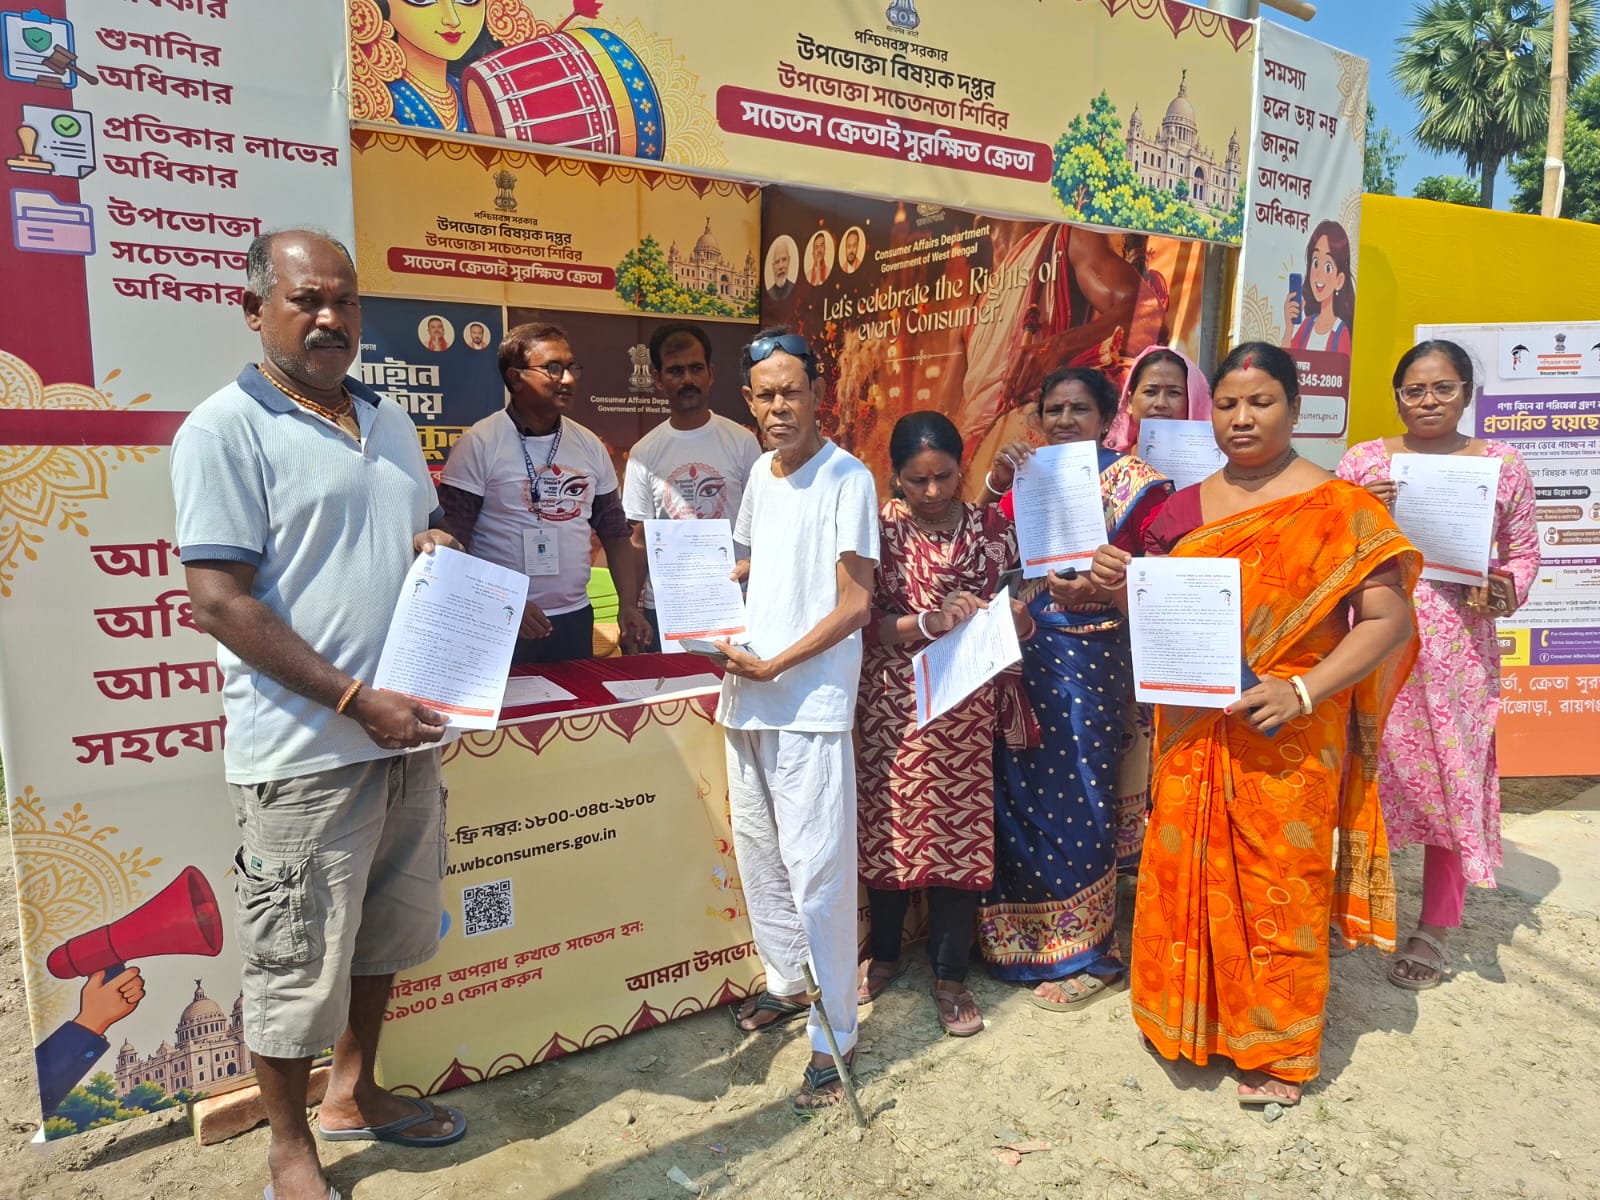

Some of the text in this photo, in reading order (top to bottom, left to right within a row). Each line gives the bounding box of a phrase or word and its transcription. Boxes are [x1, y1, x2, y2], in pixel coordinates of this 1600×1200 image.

[96, 27, 222, 67] শুনানির
[854, 29, 909, 54] পশ্চিমবঙ্গ
[910, 43, 949, 63] সরকার
[97, 64, 233, 105] অধিকার
[797, 33, 996, 101] উপভোক্তা বিষয়ক দপ্তর
[1264, 58, 1306, 92] সমস্যা
[778, 61, 1010, 132] উপভোক্তা সচেতনতা শিবির
[1263, 95, 1338, 139] হলে ভয় নয়
[103, 114, 338, 167] প্রতিকার লাভের
[740, 100, 1035, 172] সচেতন ক্রেতাই সুরক্ষিত ক্রেতা
[1261, 131, 1299, 163] জানুন
[103, 152, 238, 189] অধিকার
[1258, 167, 1312, 200] আপনার
[108, 196, 262, 239] উপভোক্তা
[437, 216, 572, 246] উপভোক্তা বিষয়ক দপ্তর
[511, 216, 538, 227] সরকার
[1255, 198, 1310, 234] অধিকার
[110, 241, 248, 271] সচেতনত
[425, 232, 583, 262] উপভোক্তা সচেতনতা শিবির
[875, 224, 990, 261] Consumer Affairs Department
[881, 241, 978, 273] Government of West Bengal
[402, 253, 603, 285] সচেতন ক্রেতাই সুরক্ষিত ক্রেতা
[823, 250, 1063, 322] Let's celebrate the Rights of
[113, 273, 245, 306] অধিকার
[857, 302, 1003, 344] every Consumer.
[590, 395, 670, 406] Consumer Affairs Depa
[597, 405, 637, 413] Government
[1483, 411, 1600, 433] প্রতারিত হয়েছে
[93, 657, 225, 700] আমা
[1529, 676, 1570, 691] ক্রেতা
[1576, 676, 1600, 694] সুর
[72, 715, 227, 766] সহযো
[481, 819, 522, 838] নম্বর:
[525, 793, 656, 831] ১৮০০-৩৪৫-২৮০৮
[447, 957, 509, 984] অপরাধ
[514, 942, 561, 968] রুখতে
[566, 927, 616, 952] সচেতন
[620, 920, 645, 936] হন:
[440, 992, 454, 1006] এ
[458, 979, 498, 1002] ফোন
[500, 966, 544, 990] করুন
[625, 960, 691, 993] আমরা
